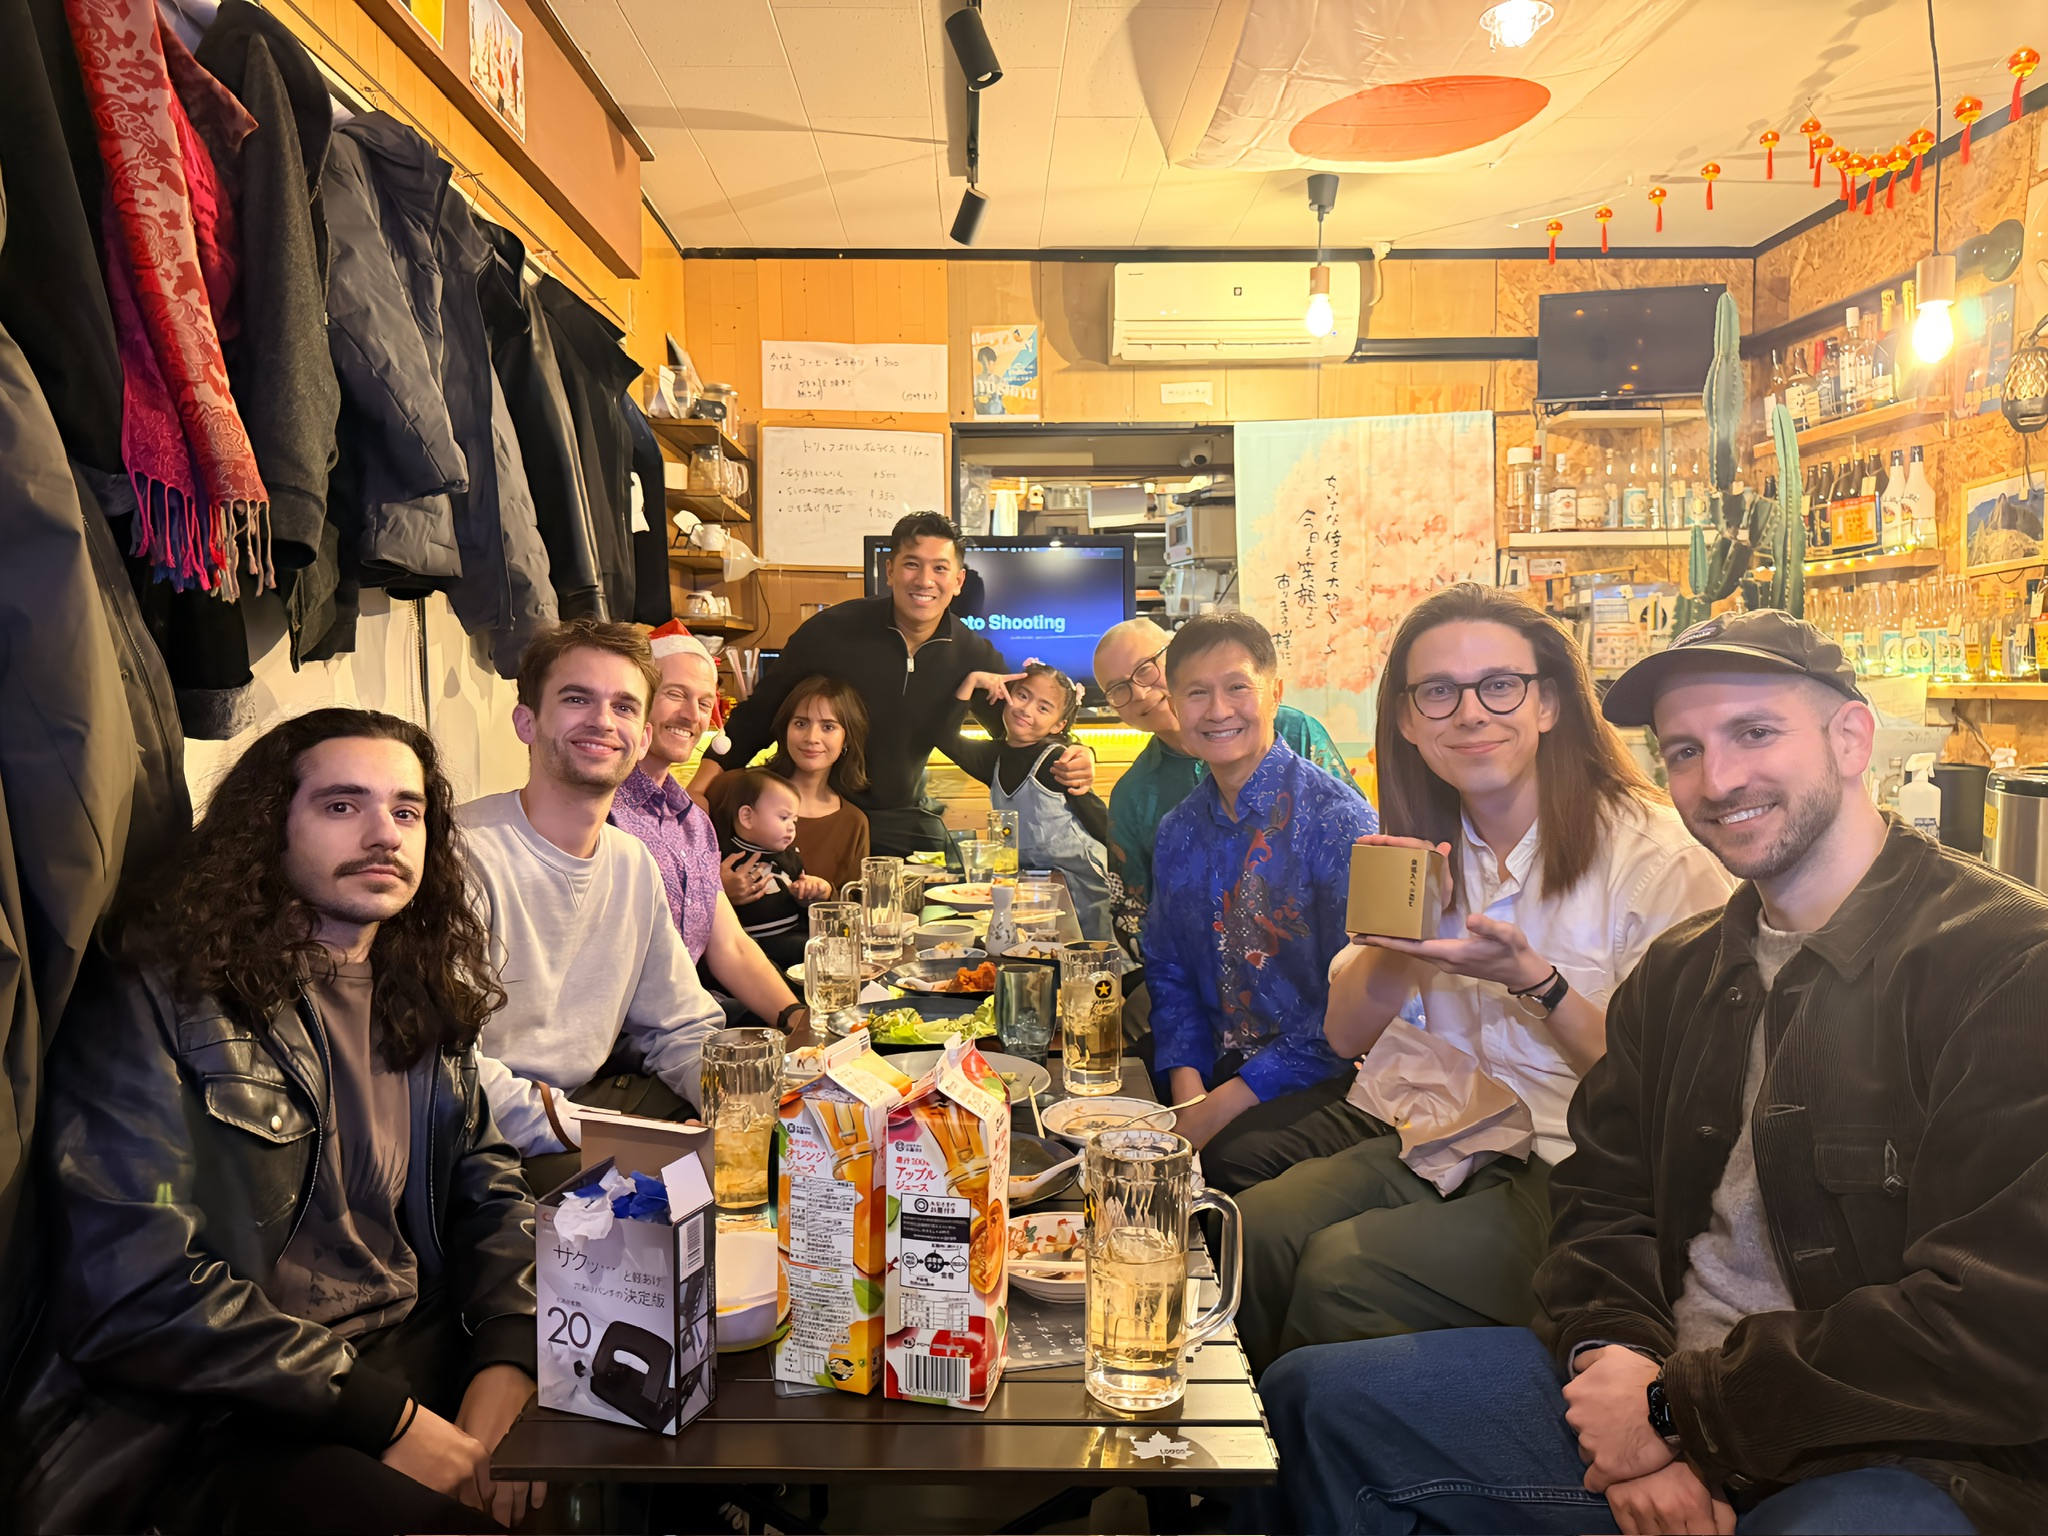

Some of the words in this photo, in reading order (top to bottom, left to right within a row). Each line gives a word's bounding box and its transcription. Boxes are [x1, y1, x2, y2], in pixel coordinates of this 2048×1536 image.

[988, 614, 1066, 633] Shooting
[786, 1148, 827, 1163] オレンジ
[786, 1160, 817, 1174] ジュース
[894, 1166, 938, 1181] アップル
[895, 1181, 929, 1193] ジュース
[547, 1306, 592, 1350] 20
